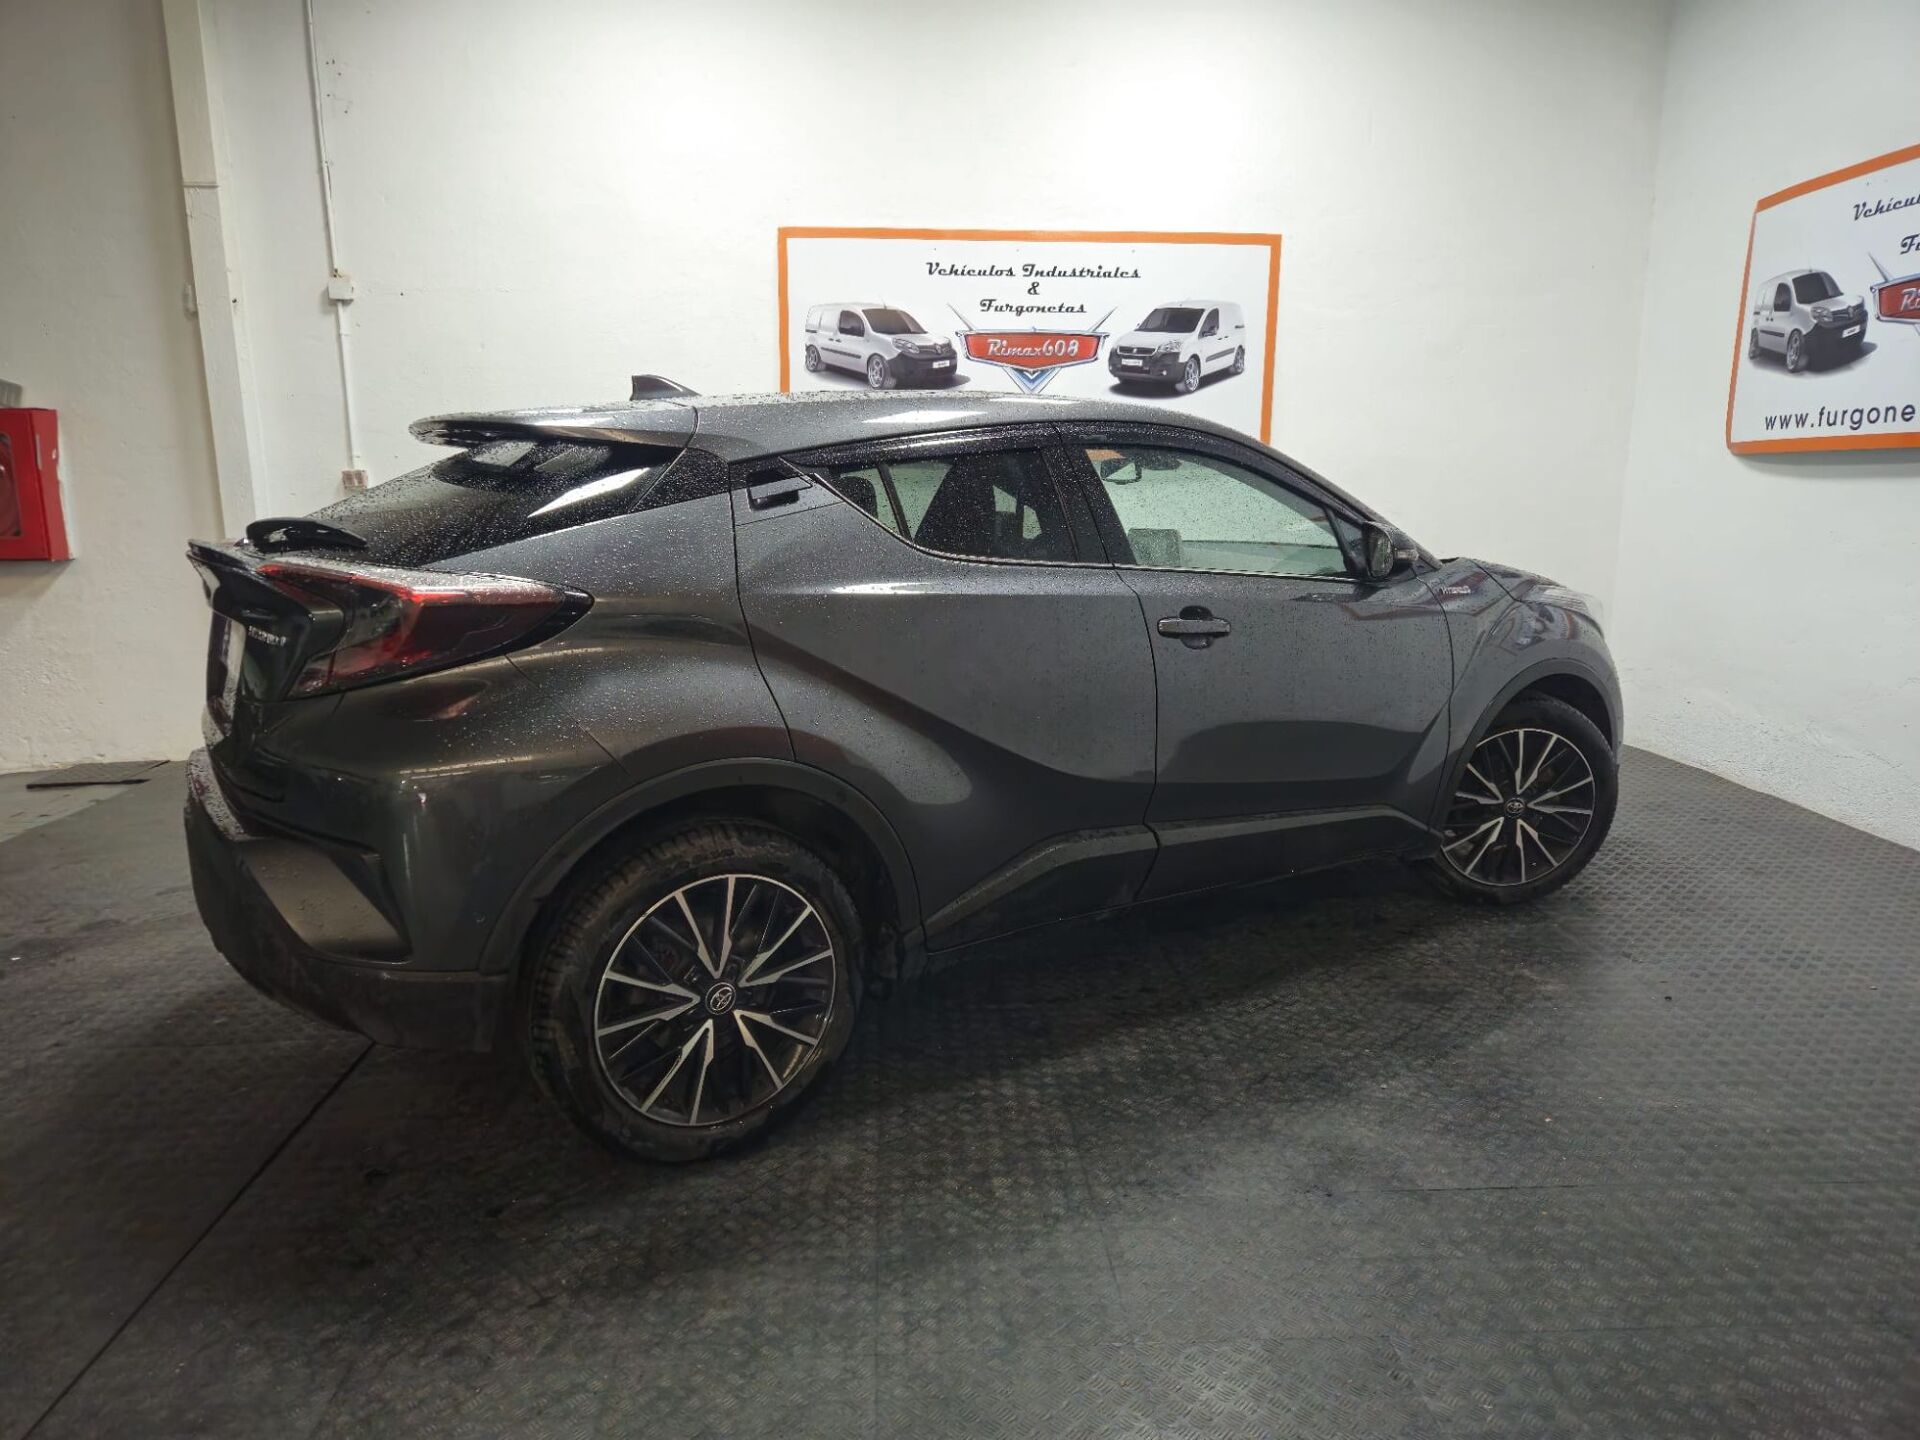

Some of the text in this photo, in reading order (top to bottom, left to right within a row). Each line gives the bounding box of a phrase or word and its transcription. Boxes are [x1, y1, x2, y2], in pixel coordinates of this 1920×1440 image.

[1022, 264, 1141, 278] Industriales
[1027, 282, 1040, 295] &
[979, 299, 1087, 316] Furgonetas
[987, 339, 1079, 356] Rimax608
[1765, 404, 1916, 431] www.furgone
